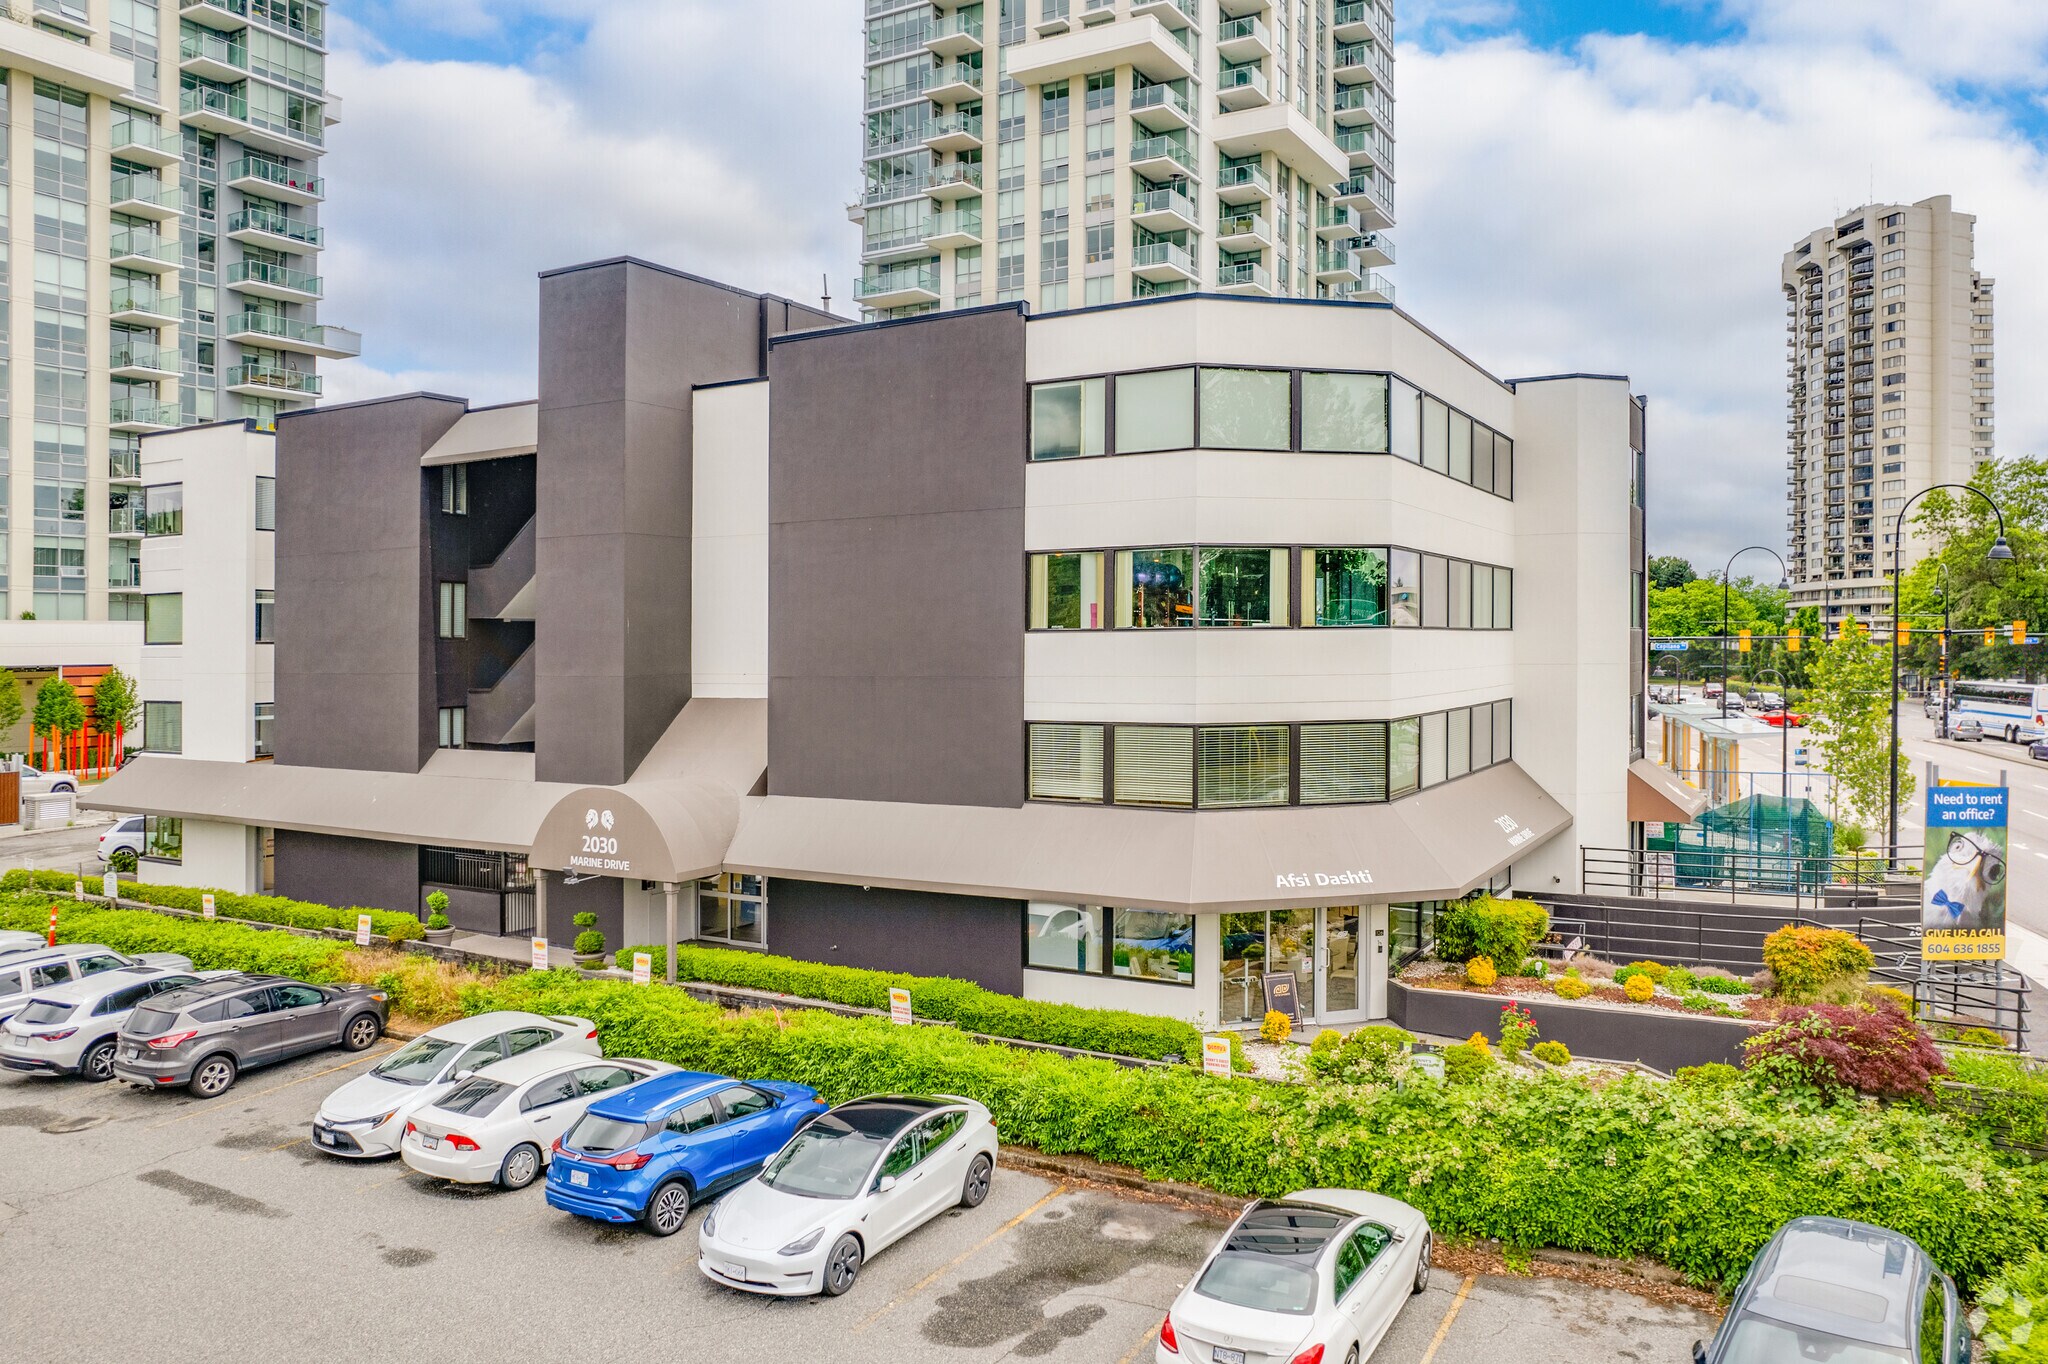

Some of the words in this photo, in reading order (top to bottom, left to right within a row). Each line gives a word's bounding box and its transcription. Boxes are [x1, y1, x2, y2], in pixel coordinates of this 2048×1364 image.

[1934, 793, 1963, 804] Need
[1965, 793, 1978, 804] to
[1980, 794, 2003, 804] rent
[1942, 810, 1956, 820] an
[1959, 808, 1995, 820] office?
[582, 835, 618, 855] 2030
[570, 855, 603, 868] MARINE
[604, 859, 630, 871] DRIVE
[1276, 873, 1311, 888] Afsi
[1314, 869, 1374, 886] Dashti
[1926, 928, 1952, 938] GIVE
[1953, 928, 1968, 938] US
[1969, 928, 1977, 938] A
[1978, 928, 2002, 937] CALL
[1927, 943, 1950, 954] 604
[1953, 943, 1974, 954] 636
[1977, 943, 2000, 953] 1855
[1207, 1044, 1226, 1052] Denny's
